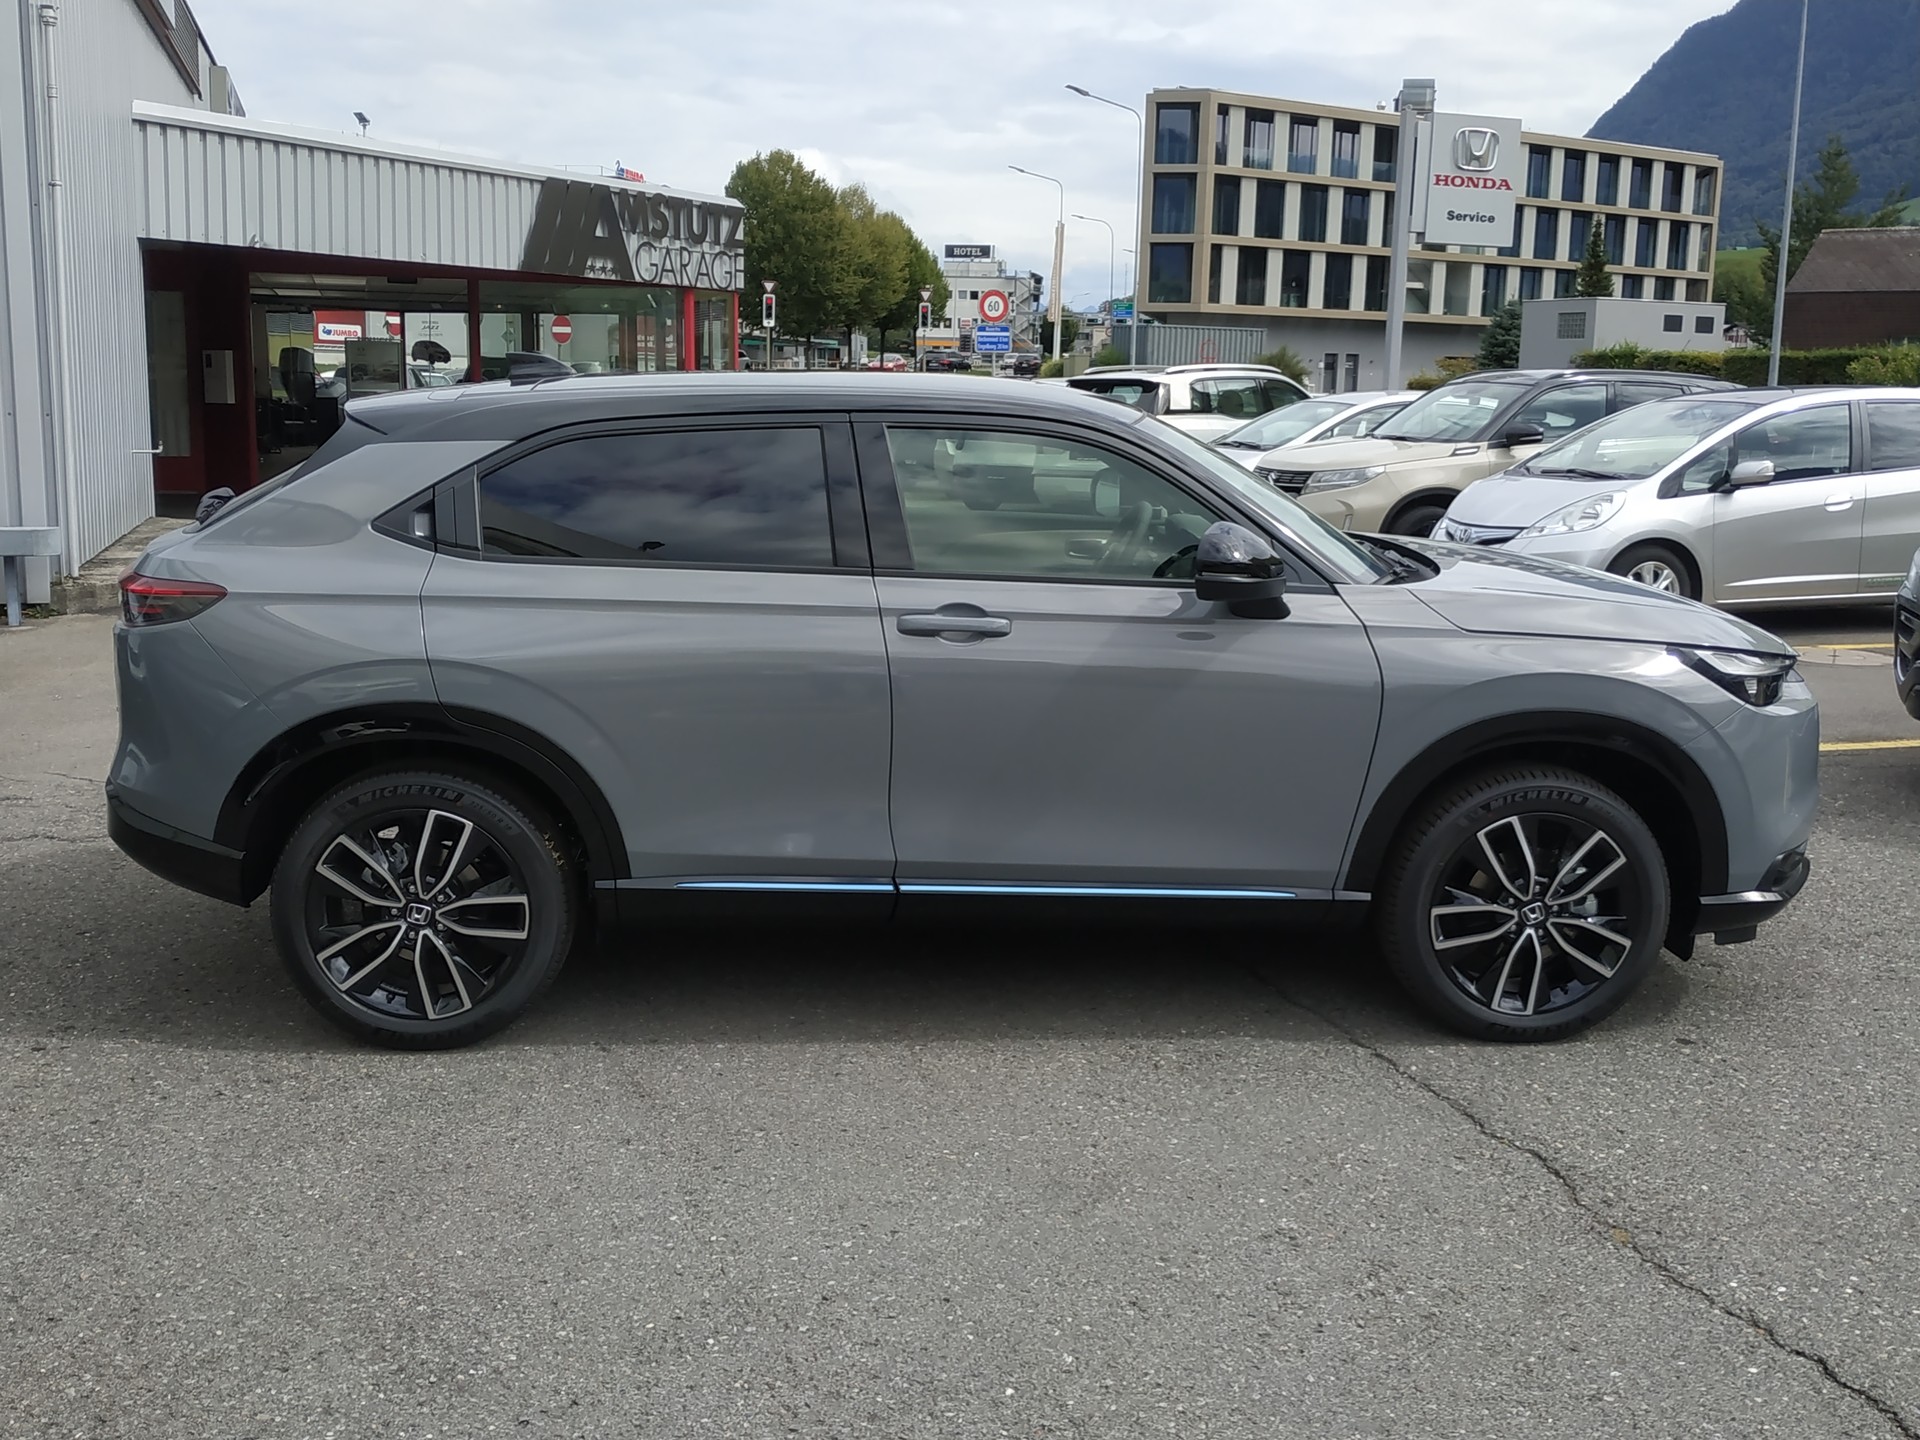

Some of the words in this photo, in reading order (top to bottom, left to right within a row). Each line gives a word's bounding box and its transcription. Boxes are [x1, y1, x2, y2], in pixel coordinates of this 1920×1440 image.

[1433, 174, 1513, 191] HONDA
[1447, 209, 1496, 224] Service
[567, 177, 744, 281] AMSTUTZ
[953, 247, 983, 256] HOTEL
[635, 241, 744, 291] GARAGE
[987, 300, 1001, 313] 60
[332, 329, 358, 337] JUMBO
[357, 785, 458, 803] MICHELIN
[1489, 790, 1587, 809] MICHELIN
